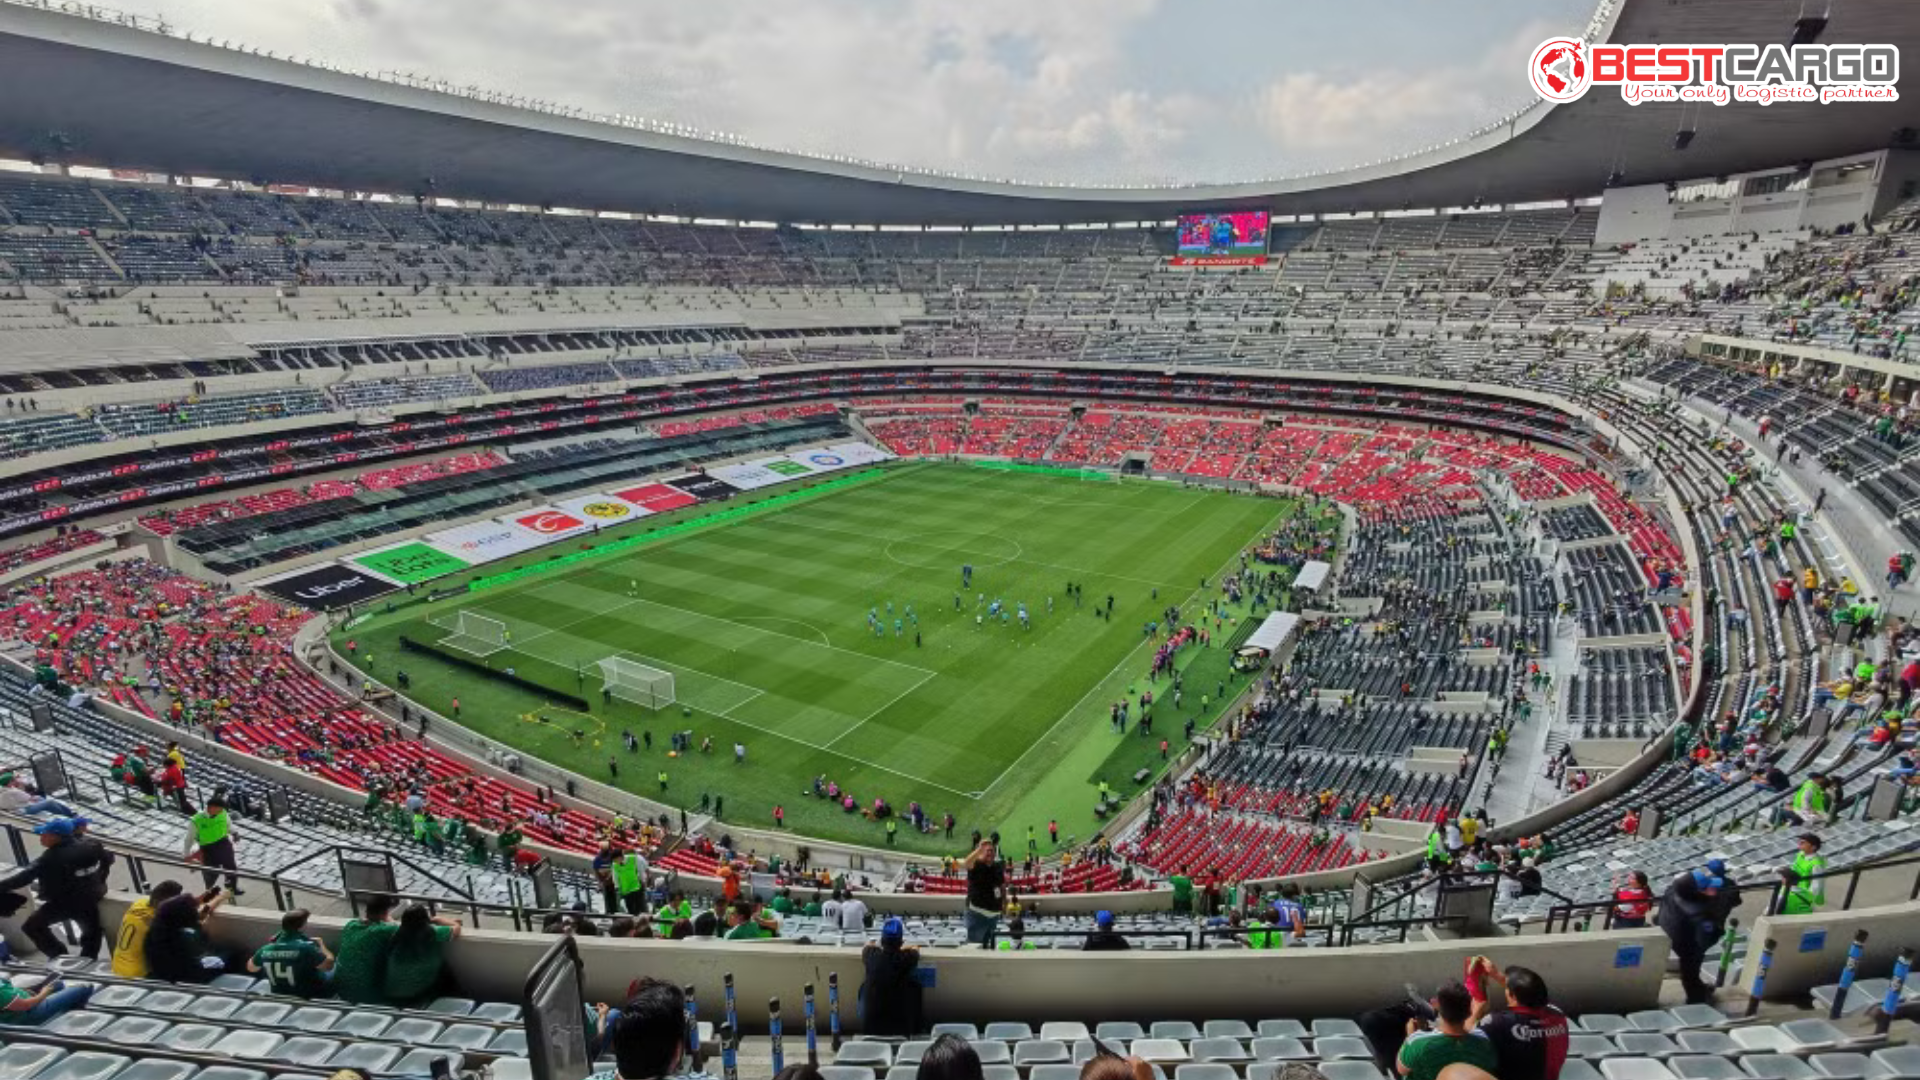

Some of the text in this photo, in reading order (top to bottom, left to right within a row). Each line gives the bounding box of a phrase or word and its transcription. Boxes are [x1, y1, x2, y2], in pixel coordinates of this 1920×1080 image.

[295, 576, 364, 598] Uber
[262, 961, 296, 986] 14
[1511, 1023, 1567, 1041] Corona
